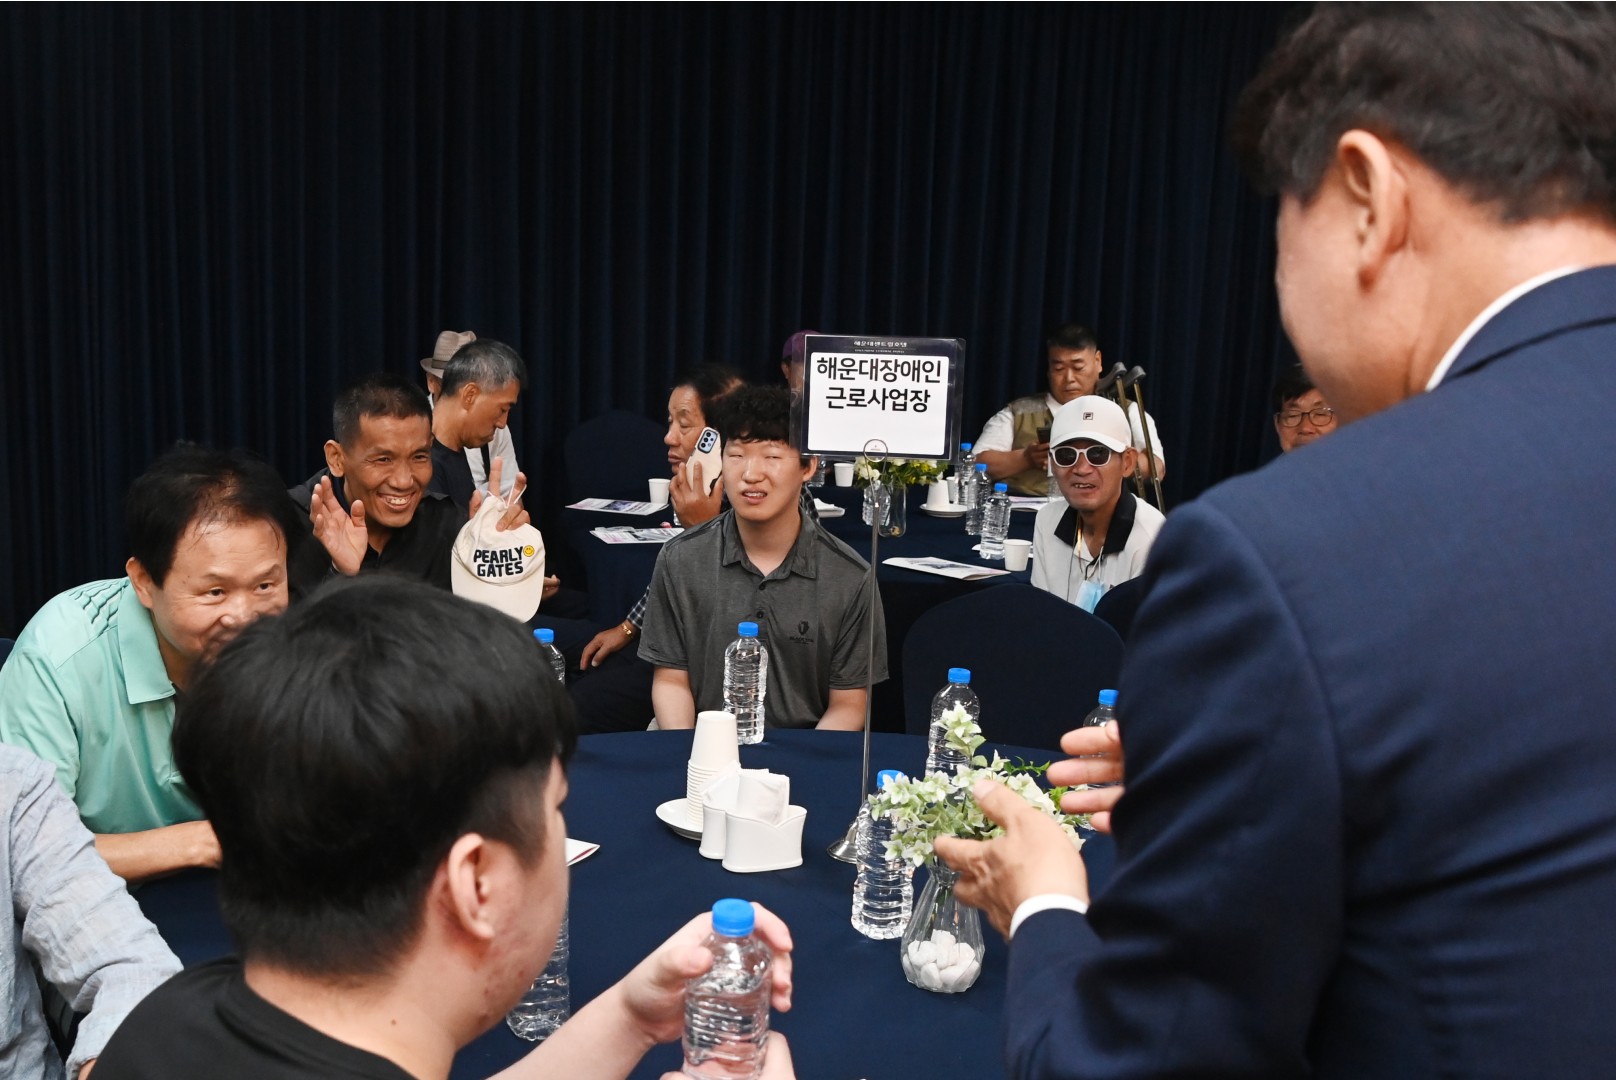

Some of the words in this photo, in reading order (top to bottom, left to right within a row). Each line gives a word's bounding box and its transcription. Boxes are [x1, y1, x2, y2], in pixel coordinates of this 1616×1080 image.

[816, 357, 941, 383] 해운대장애인
[826, 387, 931, 413] 근로사업장
[473, 546, 524, 564] PEARLY
[477, 561, 524, 577] GATES
